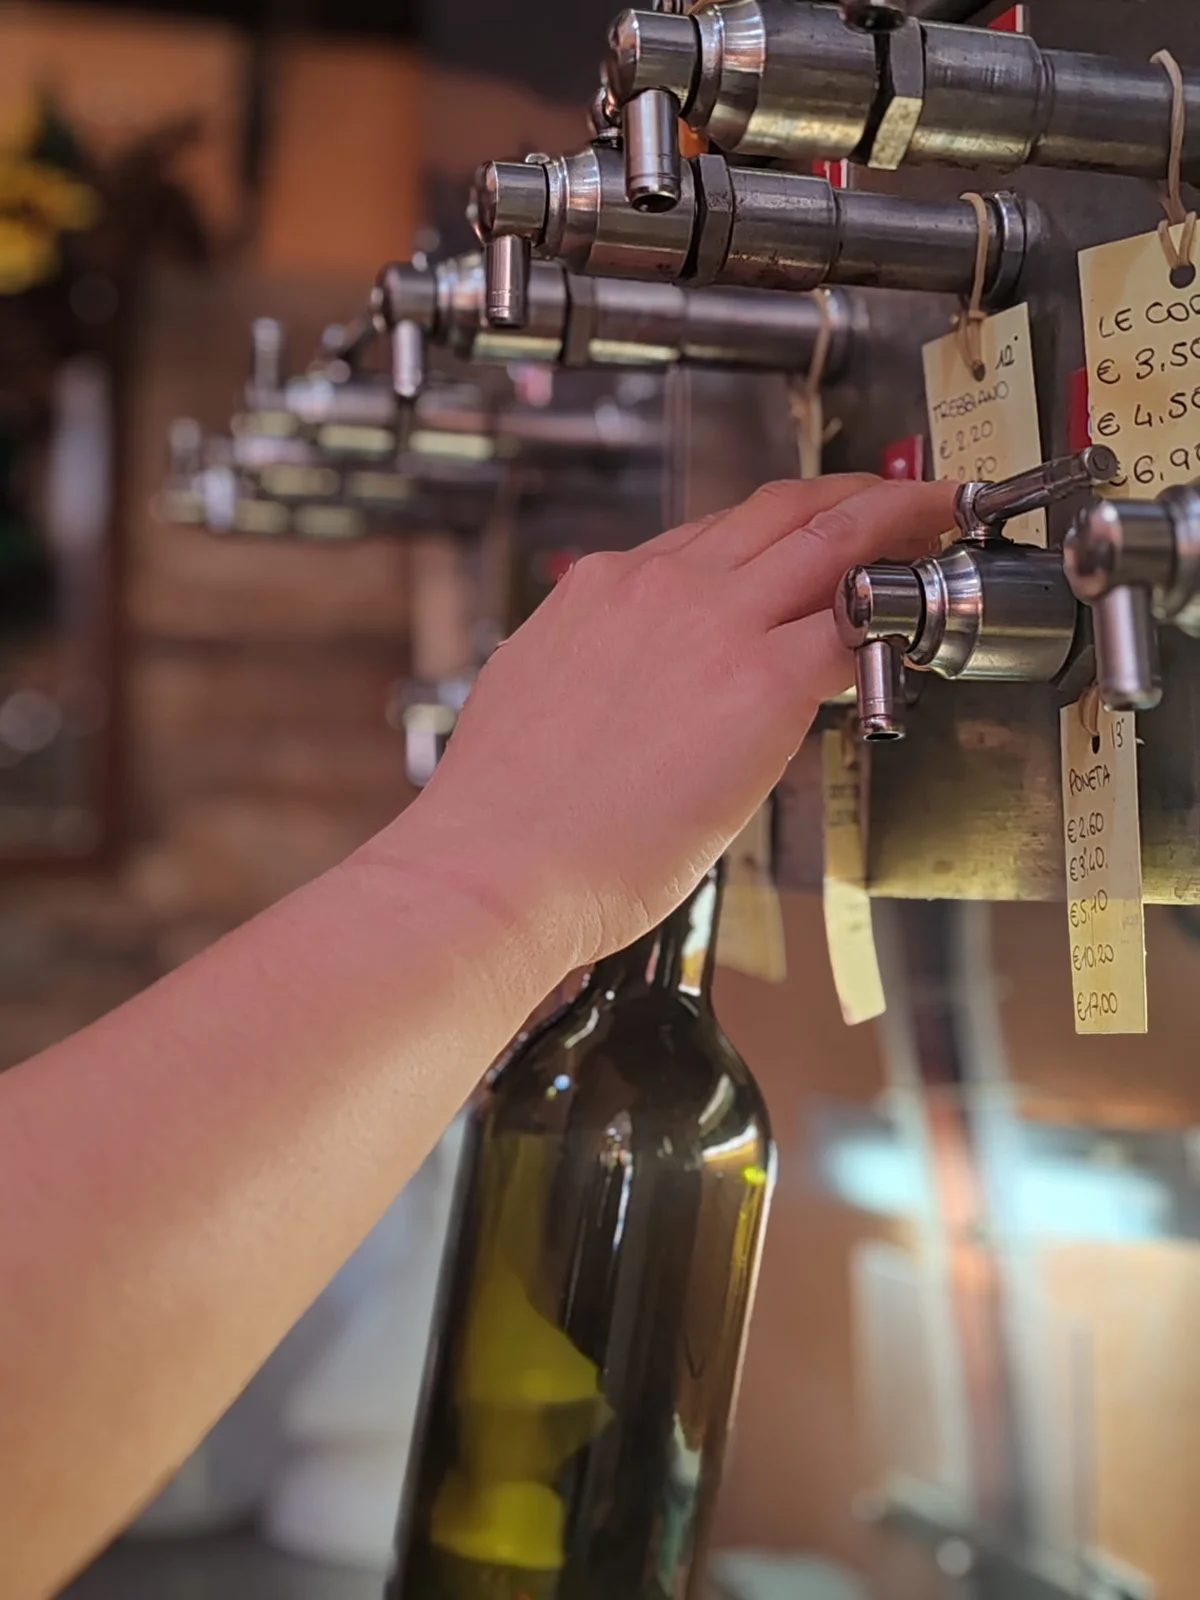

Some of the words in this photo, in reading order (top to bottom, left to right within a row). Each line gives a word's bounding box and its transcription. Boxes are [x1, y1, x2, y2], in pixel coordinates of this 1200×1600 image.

[1099, 307, 1133, 338] LE
[1097, 358, 1121, 385] €
[1097, 412, 1120, 437] €
